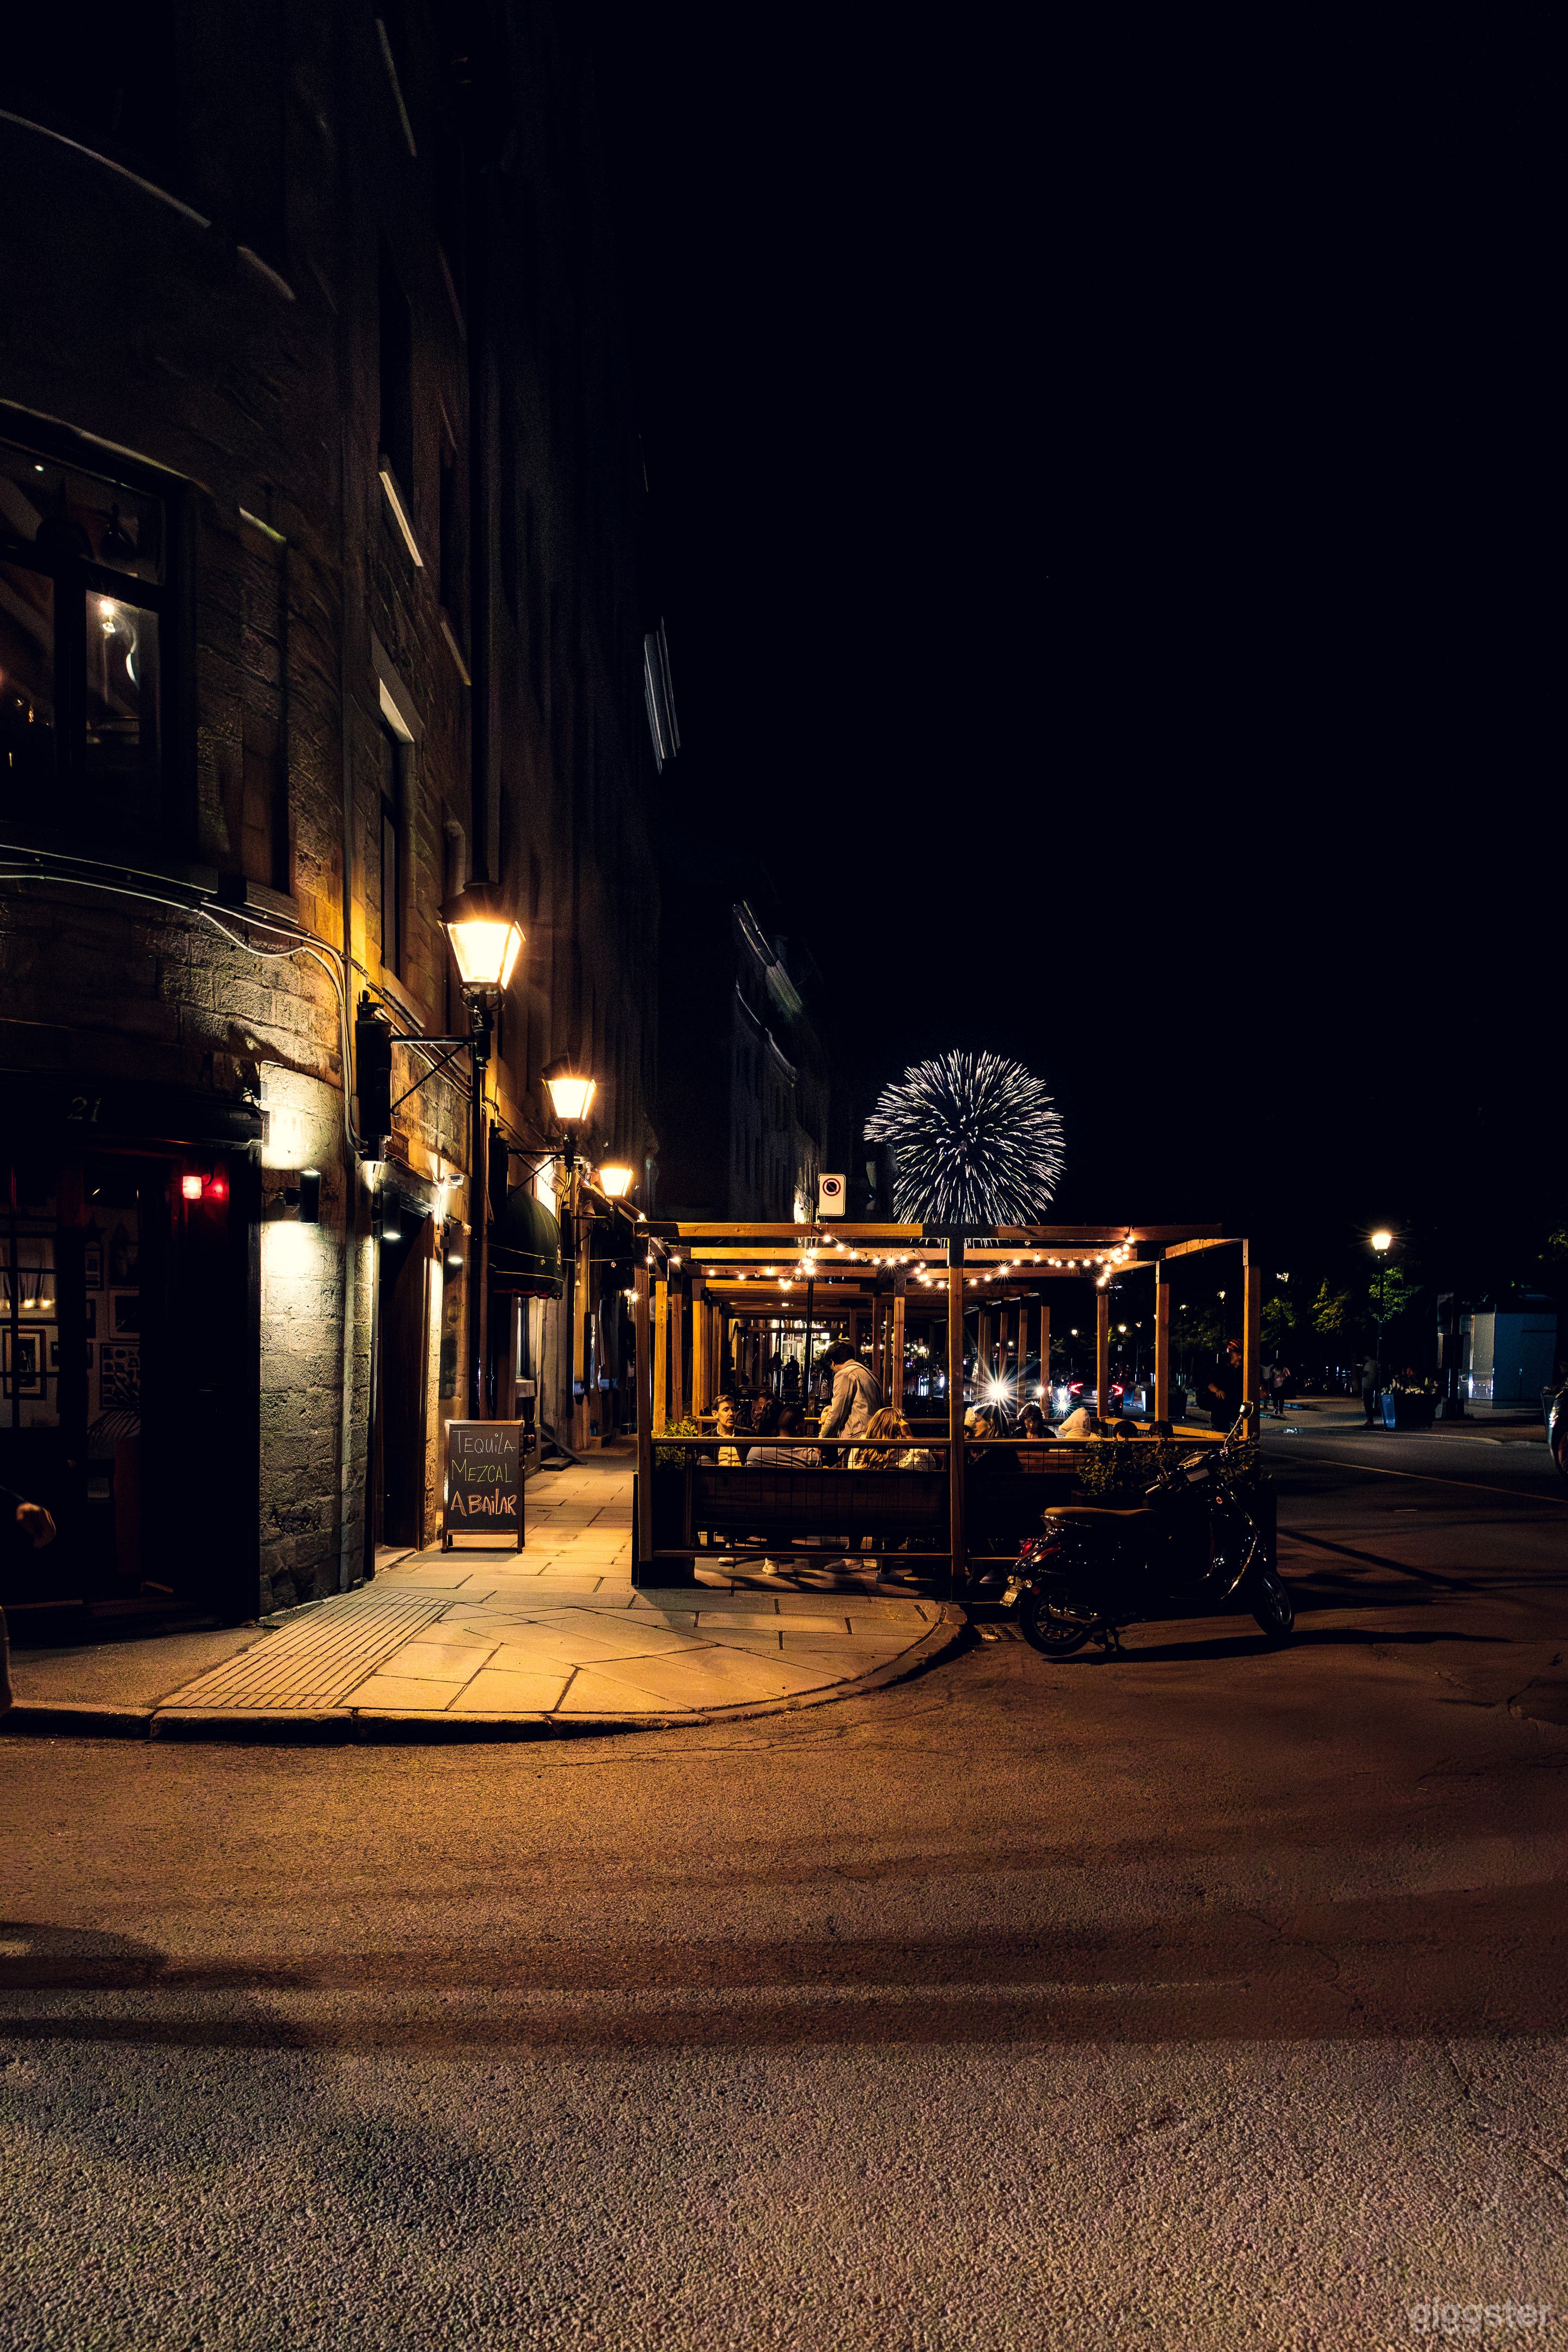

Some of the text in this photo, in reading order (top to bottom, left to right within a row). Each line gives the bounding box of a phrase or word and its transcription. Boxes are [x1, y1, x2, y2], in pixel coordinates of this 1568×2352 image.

[66, 1097, 102, 1123] 21
[451, 1459, 512, 1483] MEZCAL
[450, 1491, 467, 1516] A
